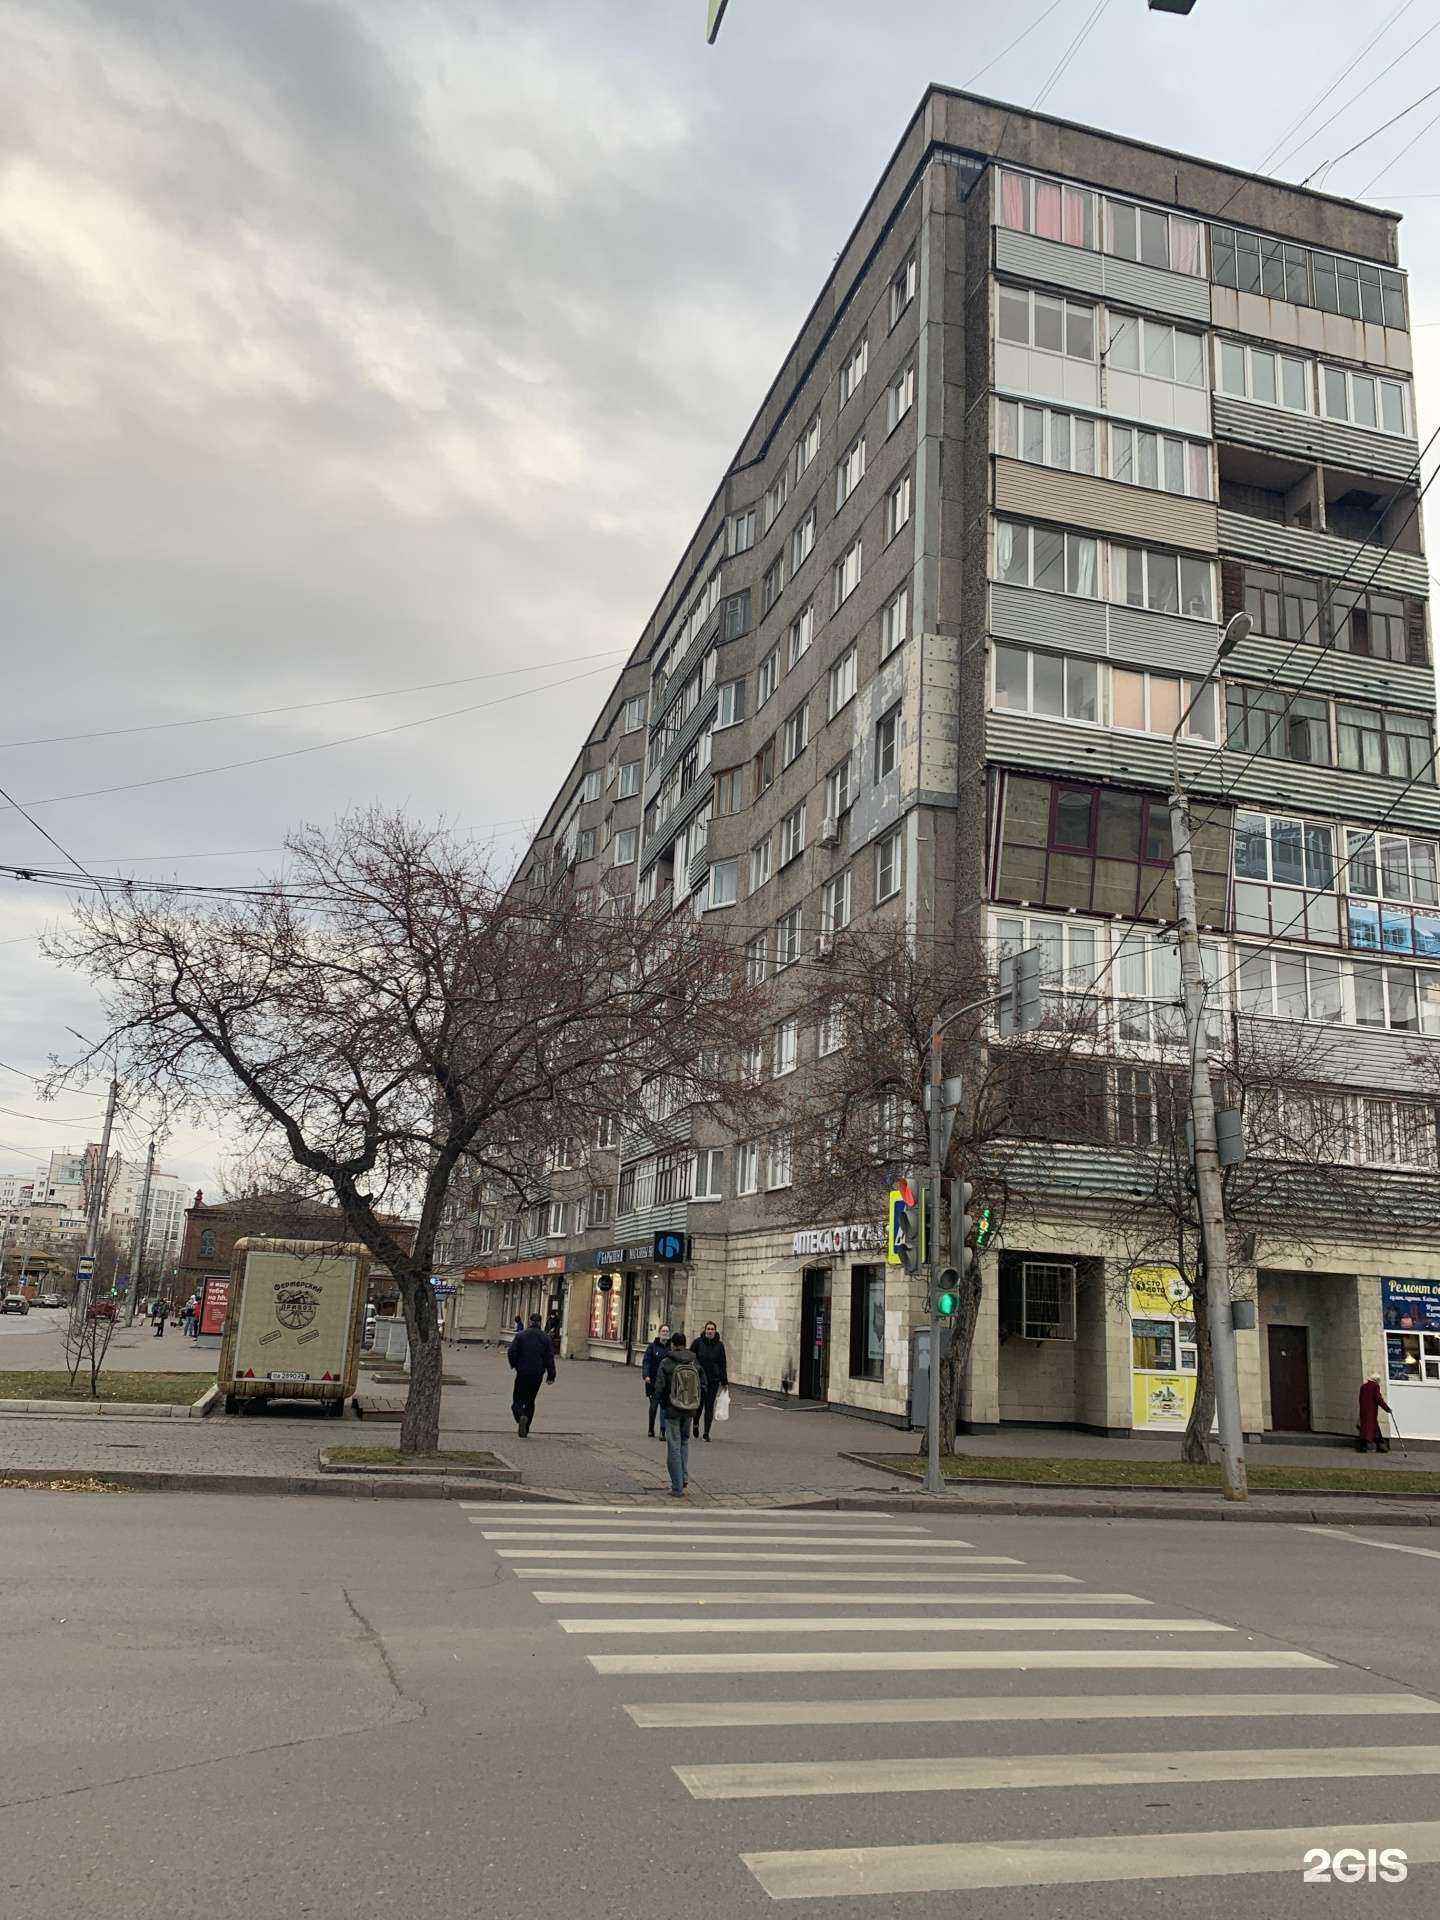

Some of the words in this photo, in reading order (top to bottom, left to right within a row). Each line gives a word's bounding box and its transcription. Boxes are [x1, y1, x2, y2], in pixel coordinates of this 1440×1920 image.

[793, 1229, 832, 1254] АПТЕКА
[274, 1281, 322, 1293] Фермерский
[1388, 1280, 1431, 1295] Ремонт
